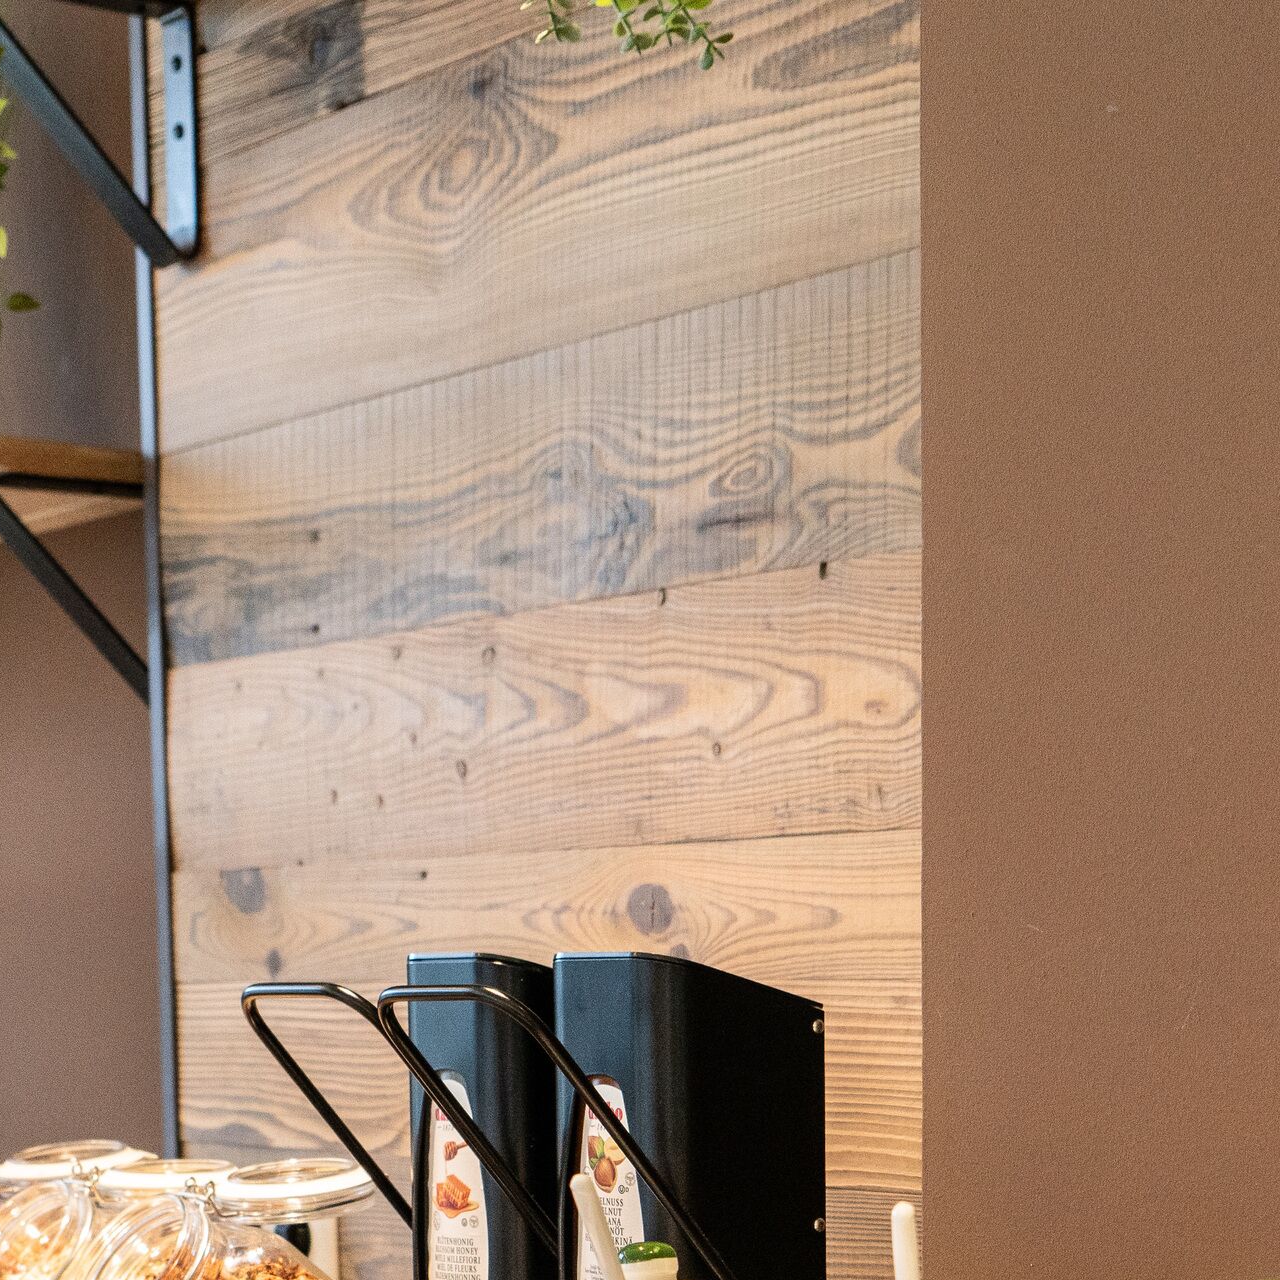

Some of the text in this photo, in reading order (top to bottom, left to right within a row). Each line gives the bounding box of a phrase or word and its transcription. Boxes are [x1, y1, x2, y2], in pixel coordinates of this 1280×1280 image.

[600, 1197, 624, 1207] ELNUSS
[456, 1246, 479, 1255] HONEY
[447, 1255, 481, 1264] MILLEFIORI
[454, 1264, 477, 1273] FLEURS
